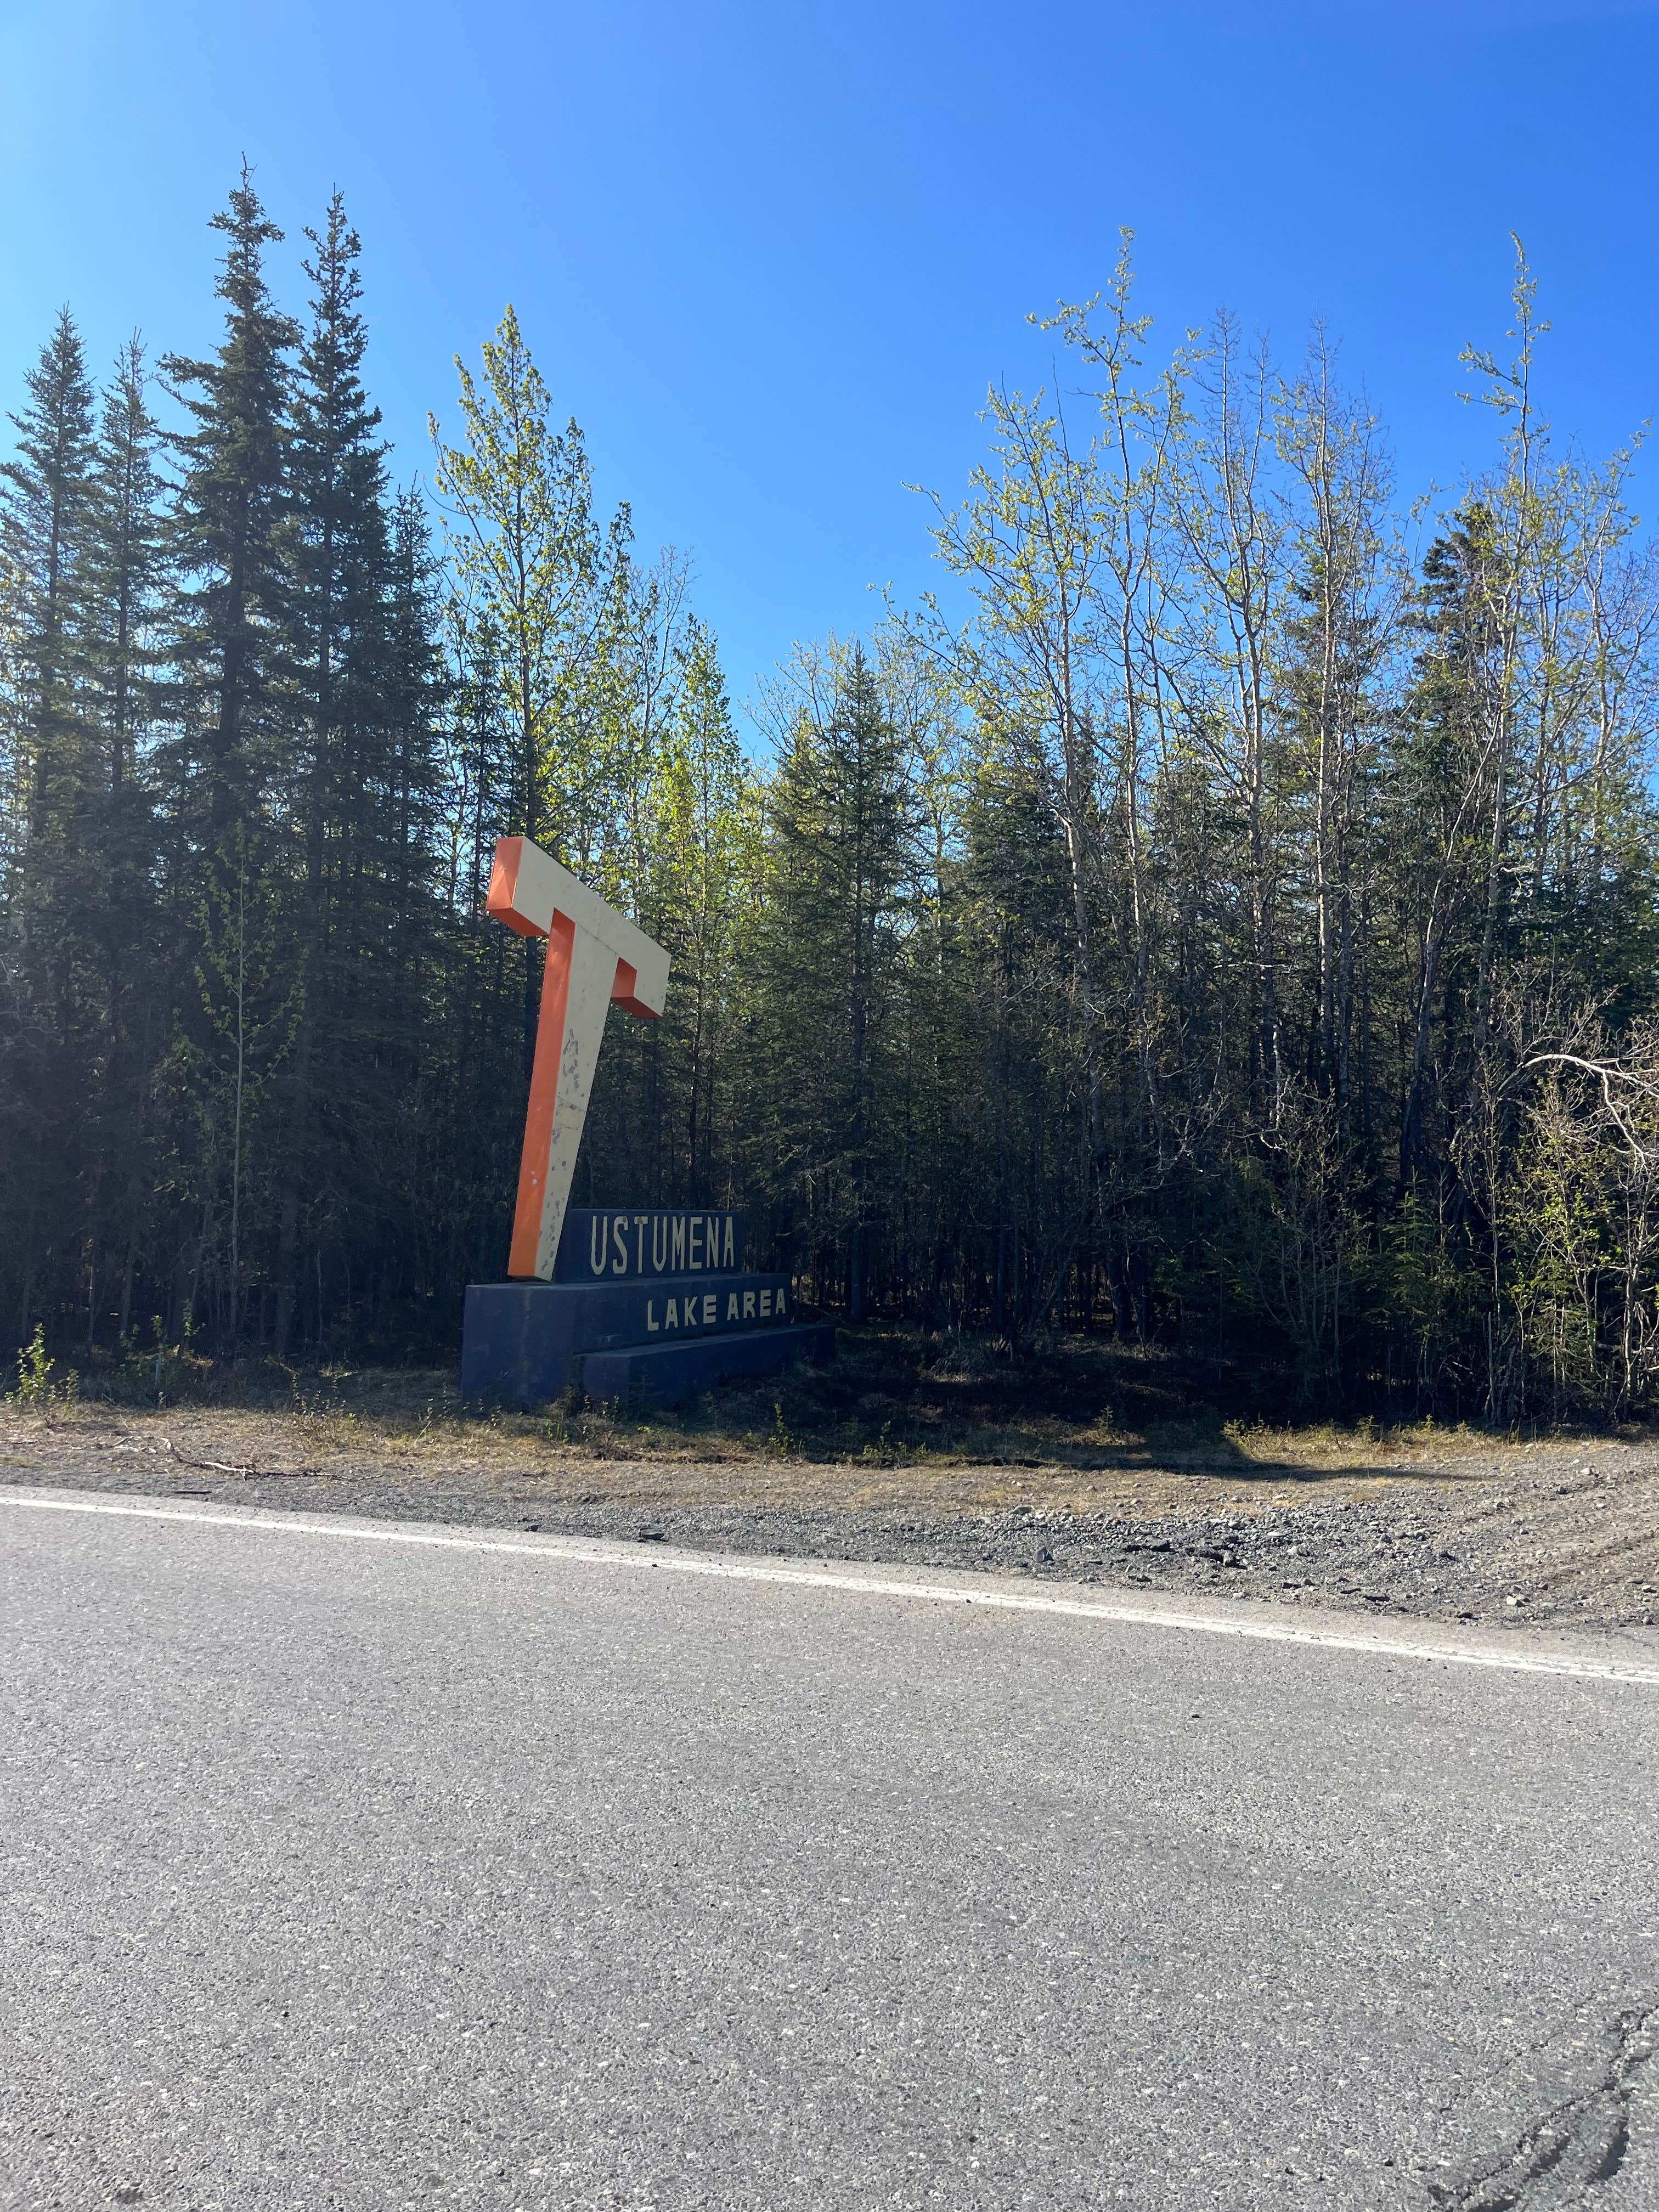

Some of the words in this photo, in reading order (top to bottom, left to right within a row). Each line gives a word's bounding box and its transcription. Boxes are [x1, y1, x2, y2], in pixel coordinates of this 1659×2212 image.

[590, 1215, 735, 1276] USTUMENA
[647, 1294, 717, 1331] LAKE
[727, 1288, 786, 1321] AREA
